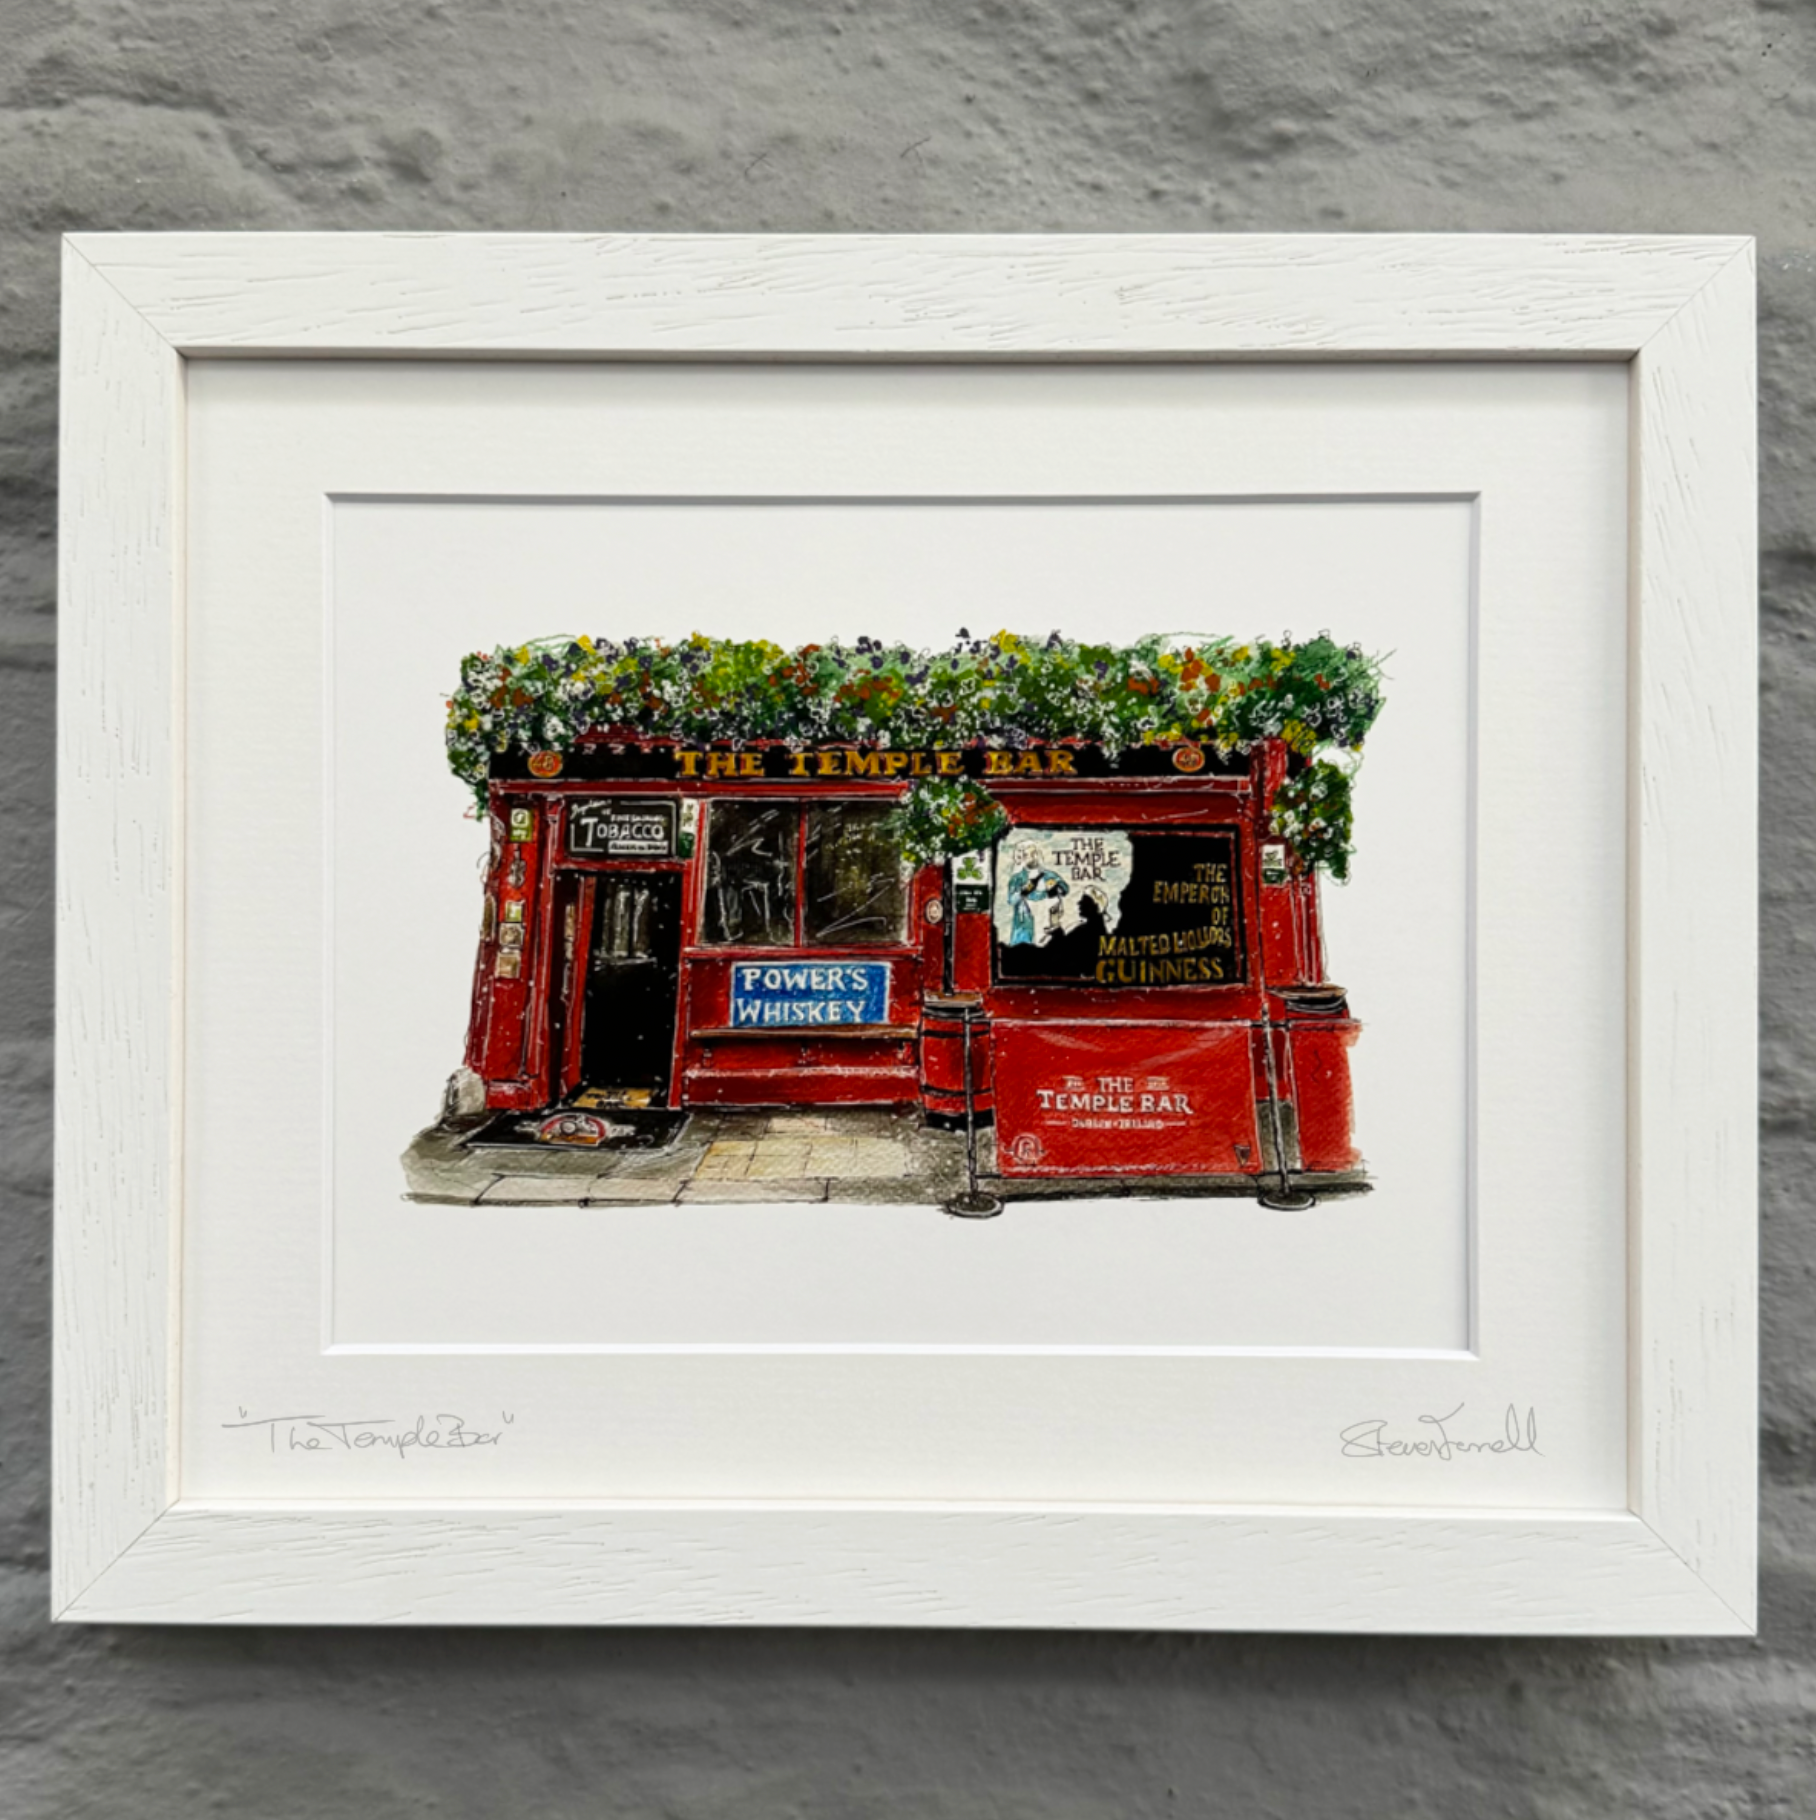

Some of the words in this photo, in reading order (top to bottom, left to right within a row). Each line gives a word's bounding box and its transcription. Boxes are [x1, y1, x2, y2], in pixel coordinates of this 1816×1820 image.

[675, 751, 765, 777] THE
[789, 750, 965, 777] TEMPLE
[984, 750, 1078, 776] BAR
[1071, 837, 1104, 850] THE
[1052, 850, 1121, 868] TEMPLE
[1071, 867, 1106, 882] BAR
[1194, 863, 1228, 882] THE
[1153, 881, 1231, 904] EMPEROR
[1211, 907, 1230, 925] OF
[1098, 933, 1170, 956] MALTED
[742, 967, 869, 992] POWER'S
[1096, 957, 1224, 983] GUINNESS
[736, 998, 866, 1023] WHISKEY
[1097, 1076, 1134, 1093] THE
[1036, 1089, 1133, 1113] TEMPLE
[1140, 1093, 1194, 1115] BAR
[306, 1414, 440, 1459] Temple
